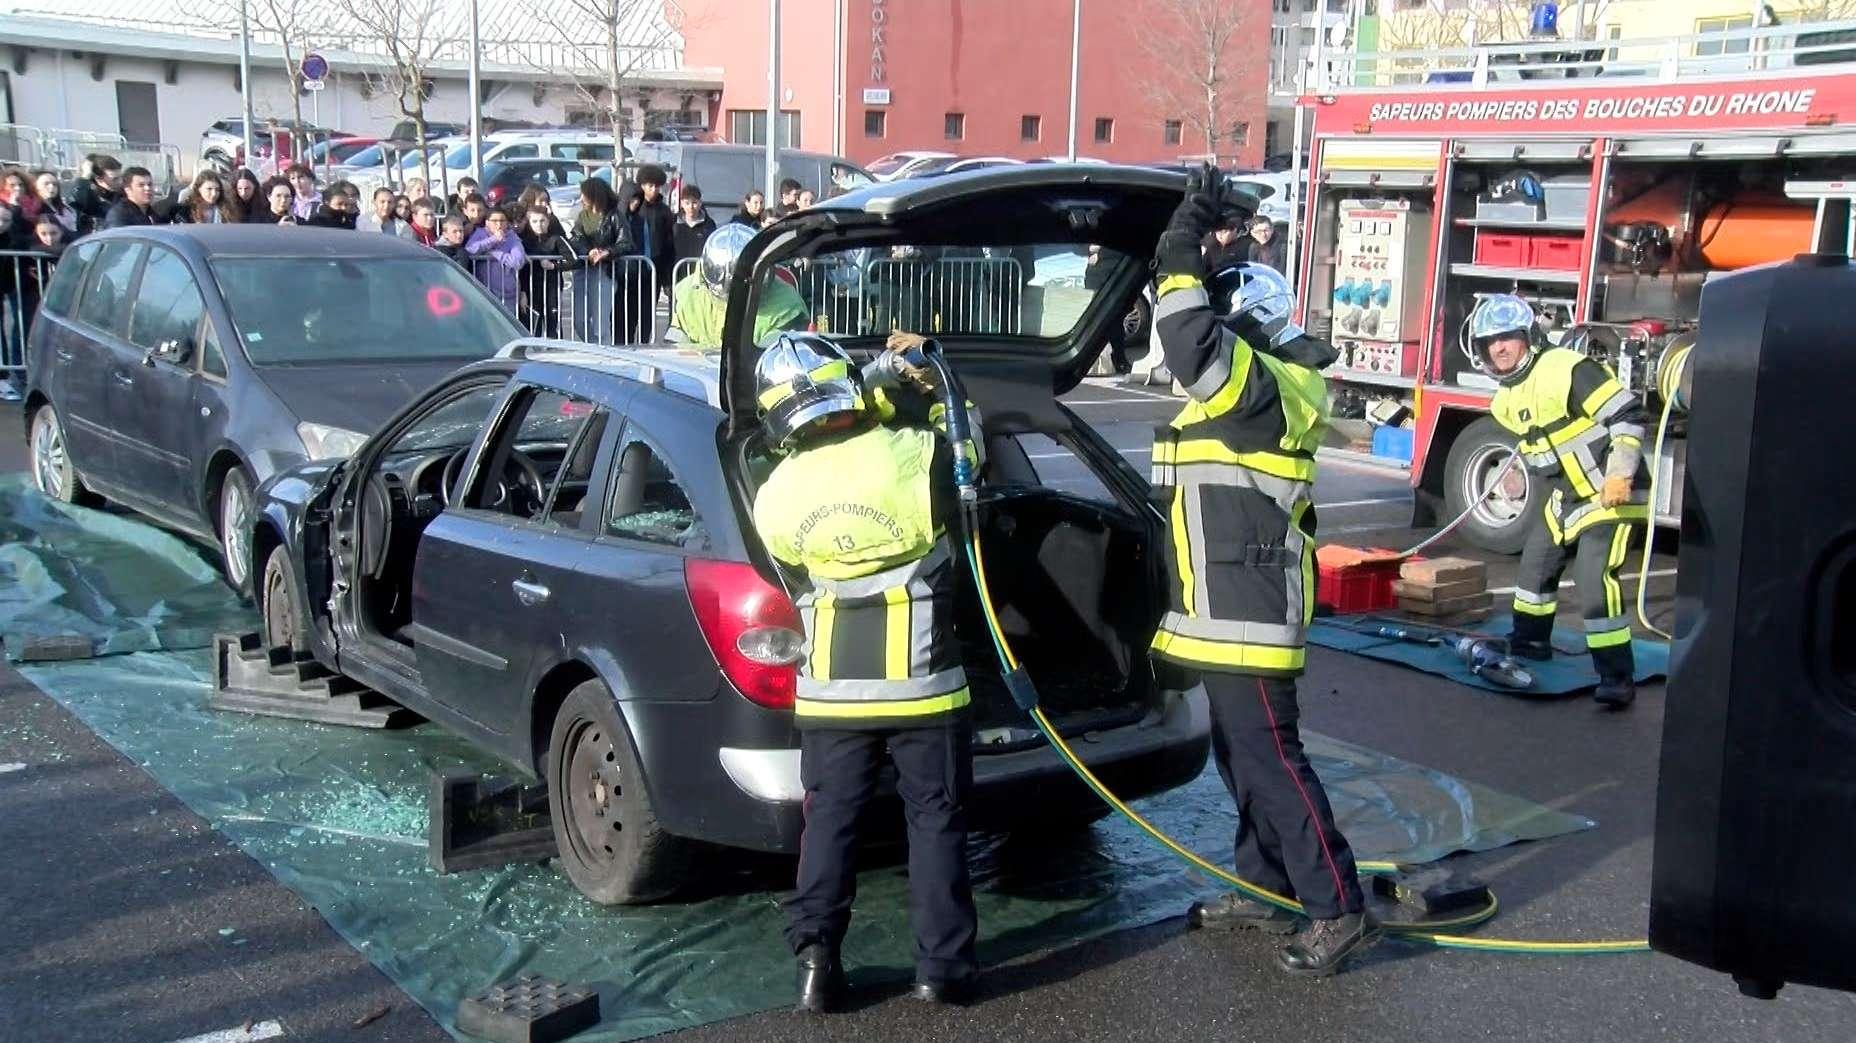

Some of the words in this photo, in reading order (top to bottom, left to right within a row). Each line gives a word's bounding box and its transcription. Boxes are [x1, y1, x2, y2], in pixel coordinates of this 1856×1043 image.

[1369, 102, 1444, 121] SAPEURS
[1446, 101, 1538, 121] POMPIERS
[1539, 100, 1579, 119] DES
[1583, 95, 1685, 118] BOUCHES
[1688, 95, 1725, 116] DU
[1725, 88, 1816, 115] RHONE
[833, 534, 856, 551] 13
